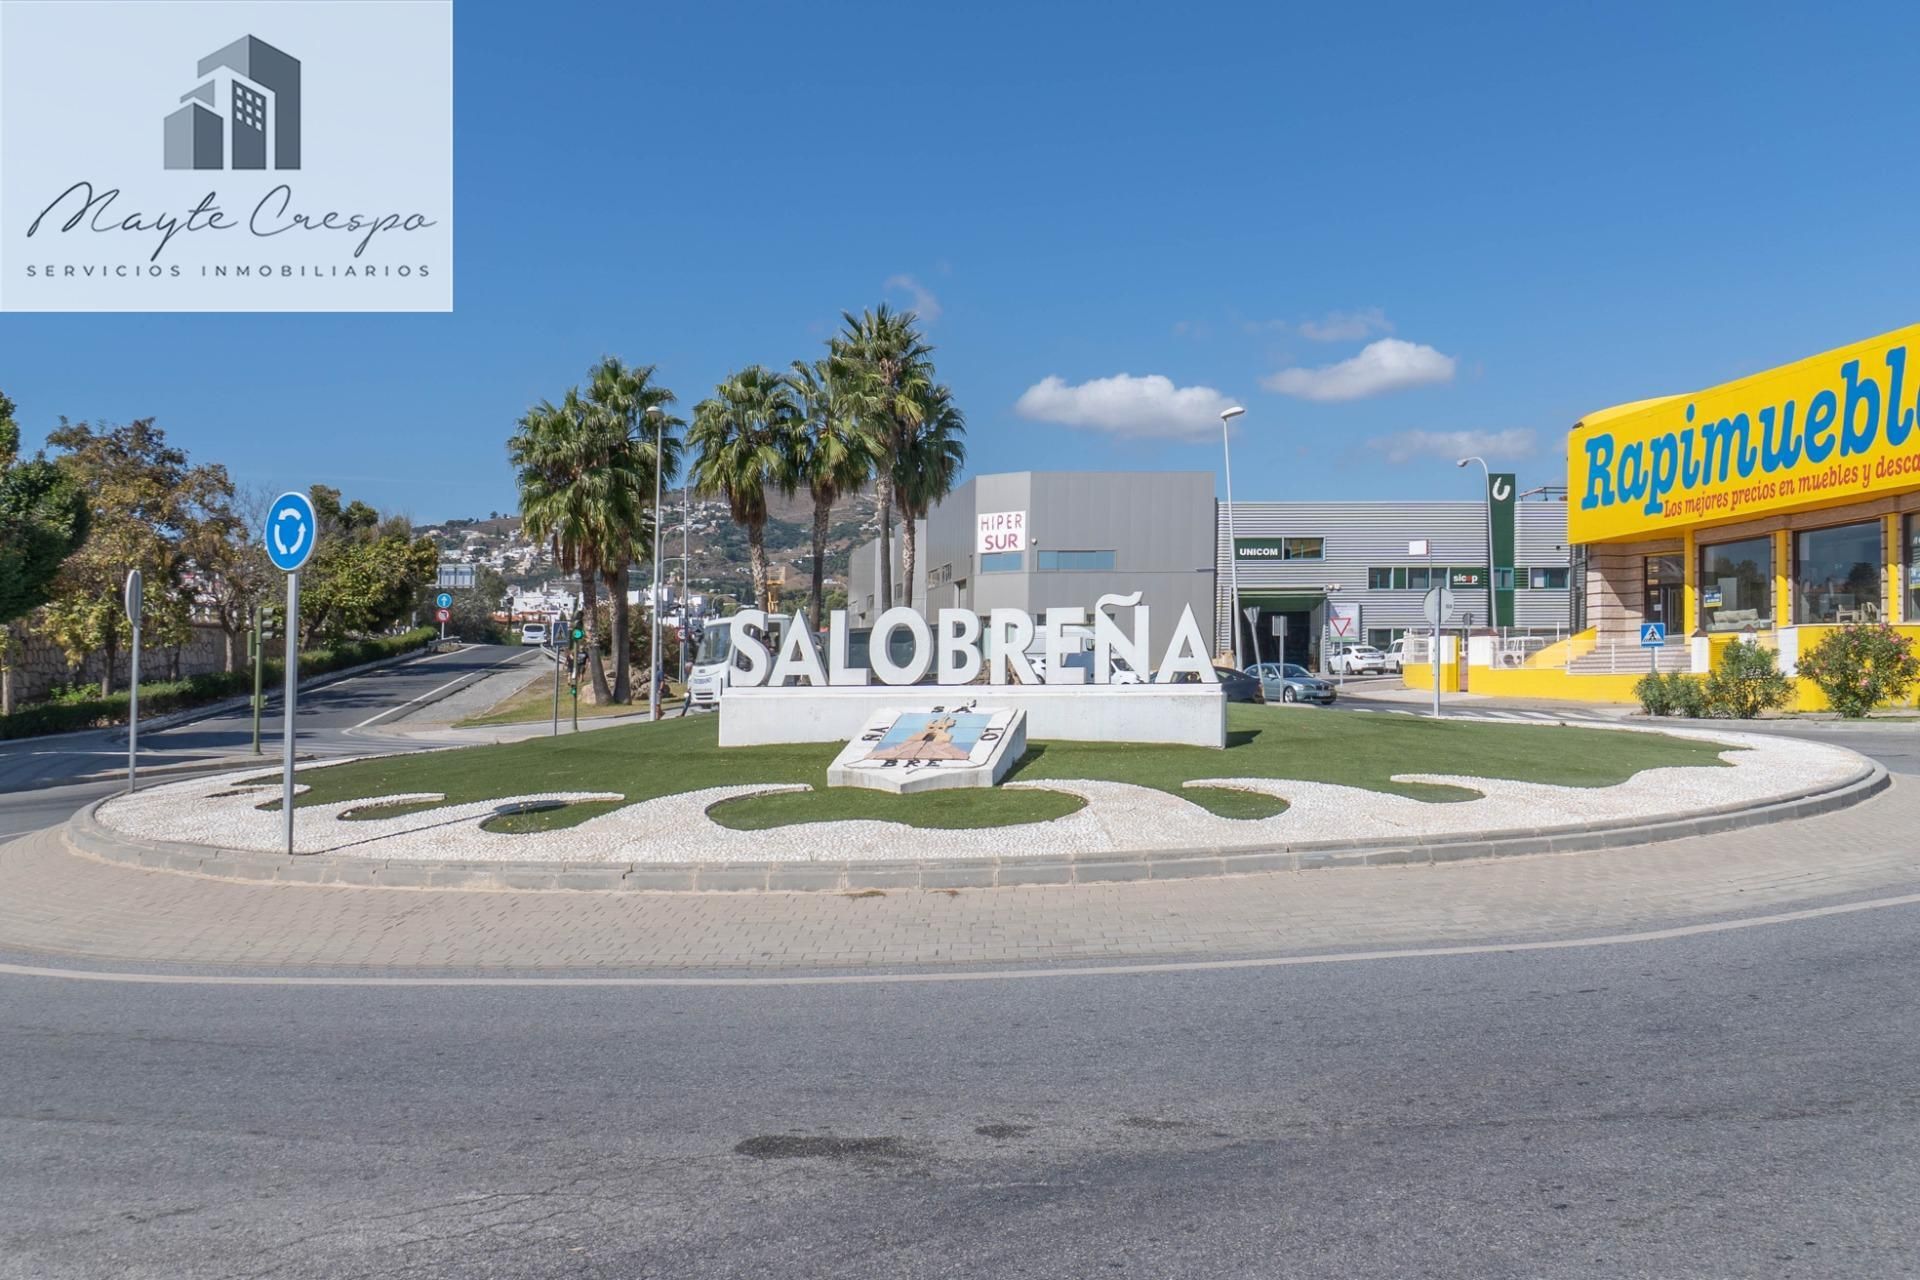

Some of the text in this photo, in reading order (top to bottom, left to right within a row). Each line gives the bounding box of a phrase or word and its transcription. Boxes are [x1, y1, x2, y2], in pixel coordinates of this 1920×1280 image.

[1580, 345, 1920, 517] Rapimuebl
[1664, 499, 1683, 518] Los
[1685, 491, 1729, 517] mejores
[1730, 480, 1776, 511] precios
[1779, 478, 1795, 497] en
[1798, 463, 1859, 494] muebles
[1862, 463, 1871, 489] y
[981, 513, 1022, 532] HIPER
[984, 533, 1018, 551] SUR
[1239, 547, 1279, 556] UNICOM
[729, 591, 1220, 687] SALOBREÑA
